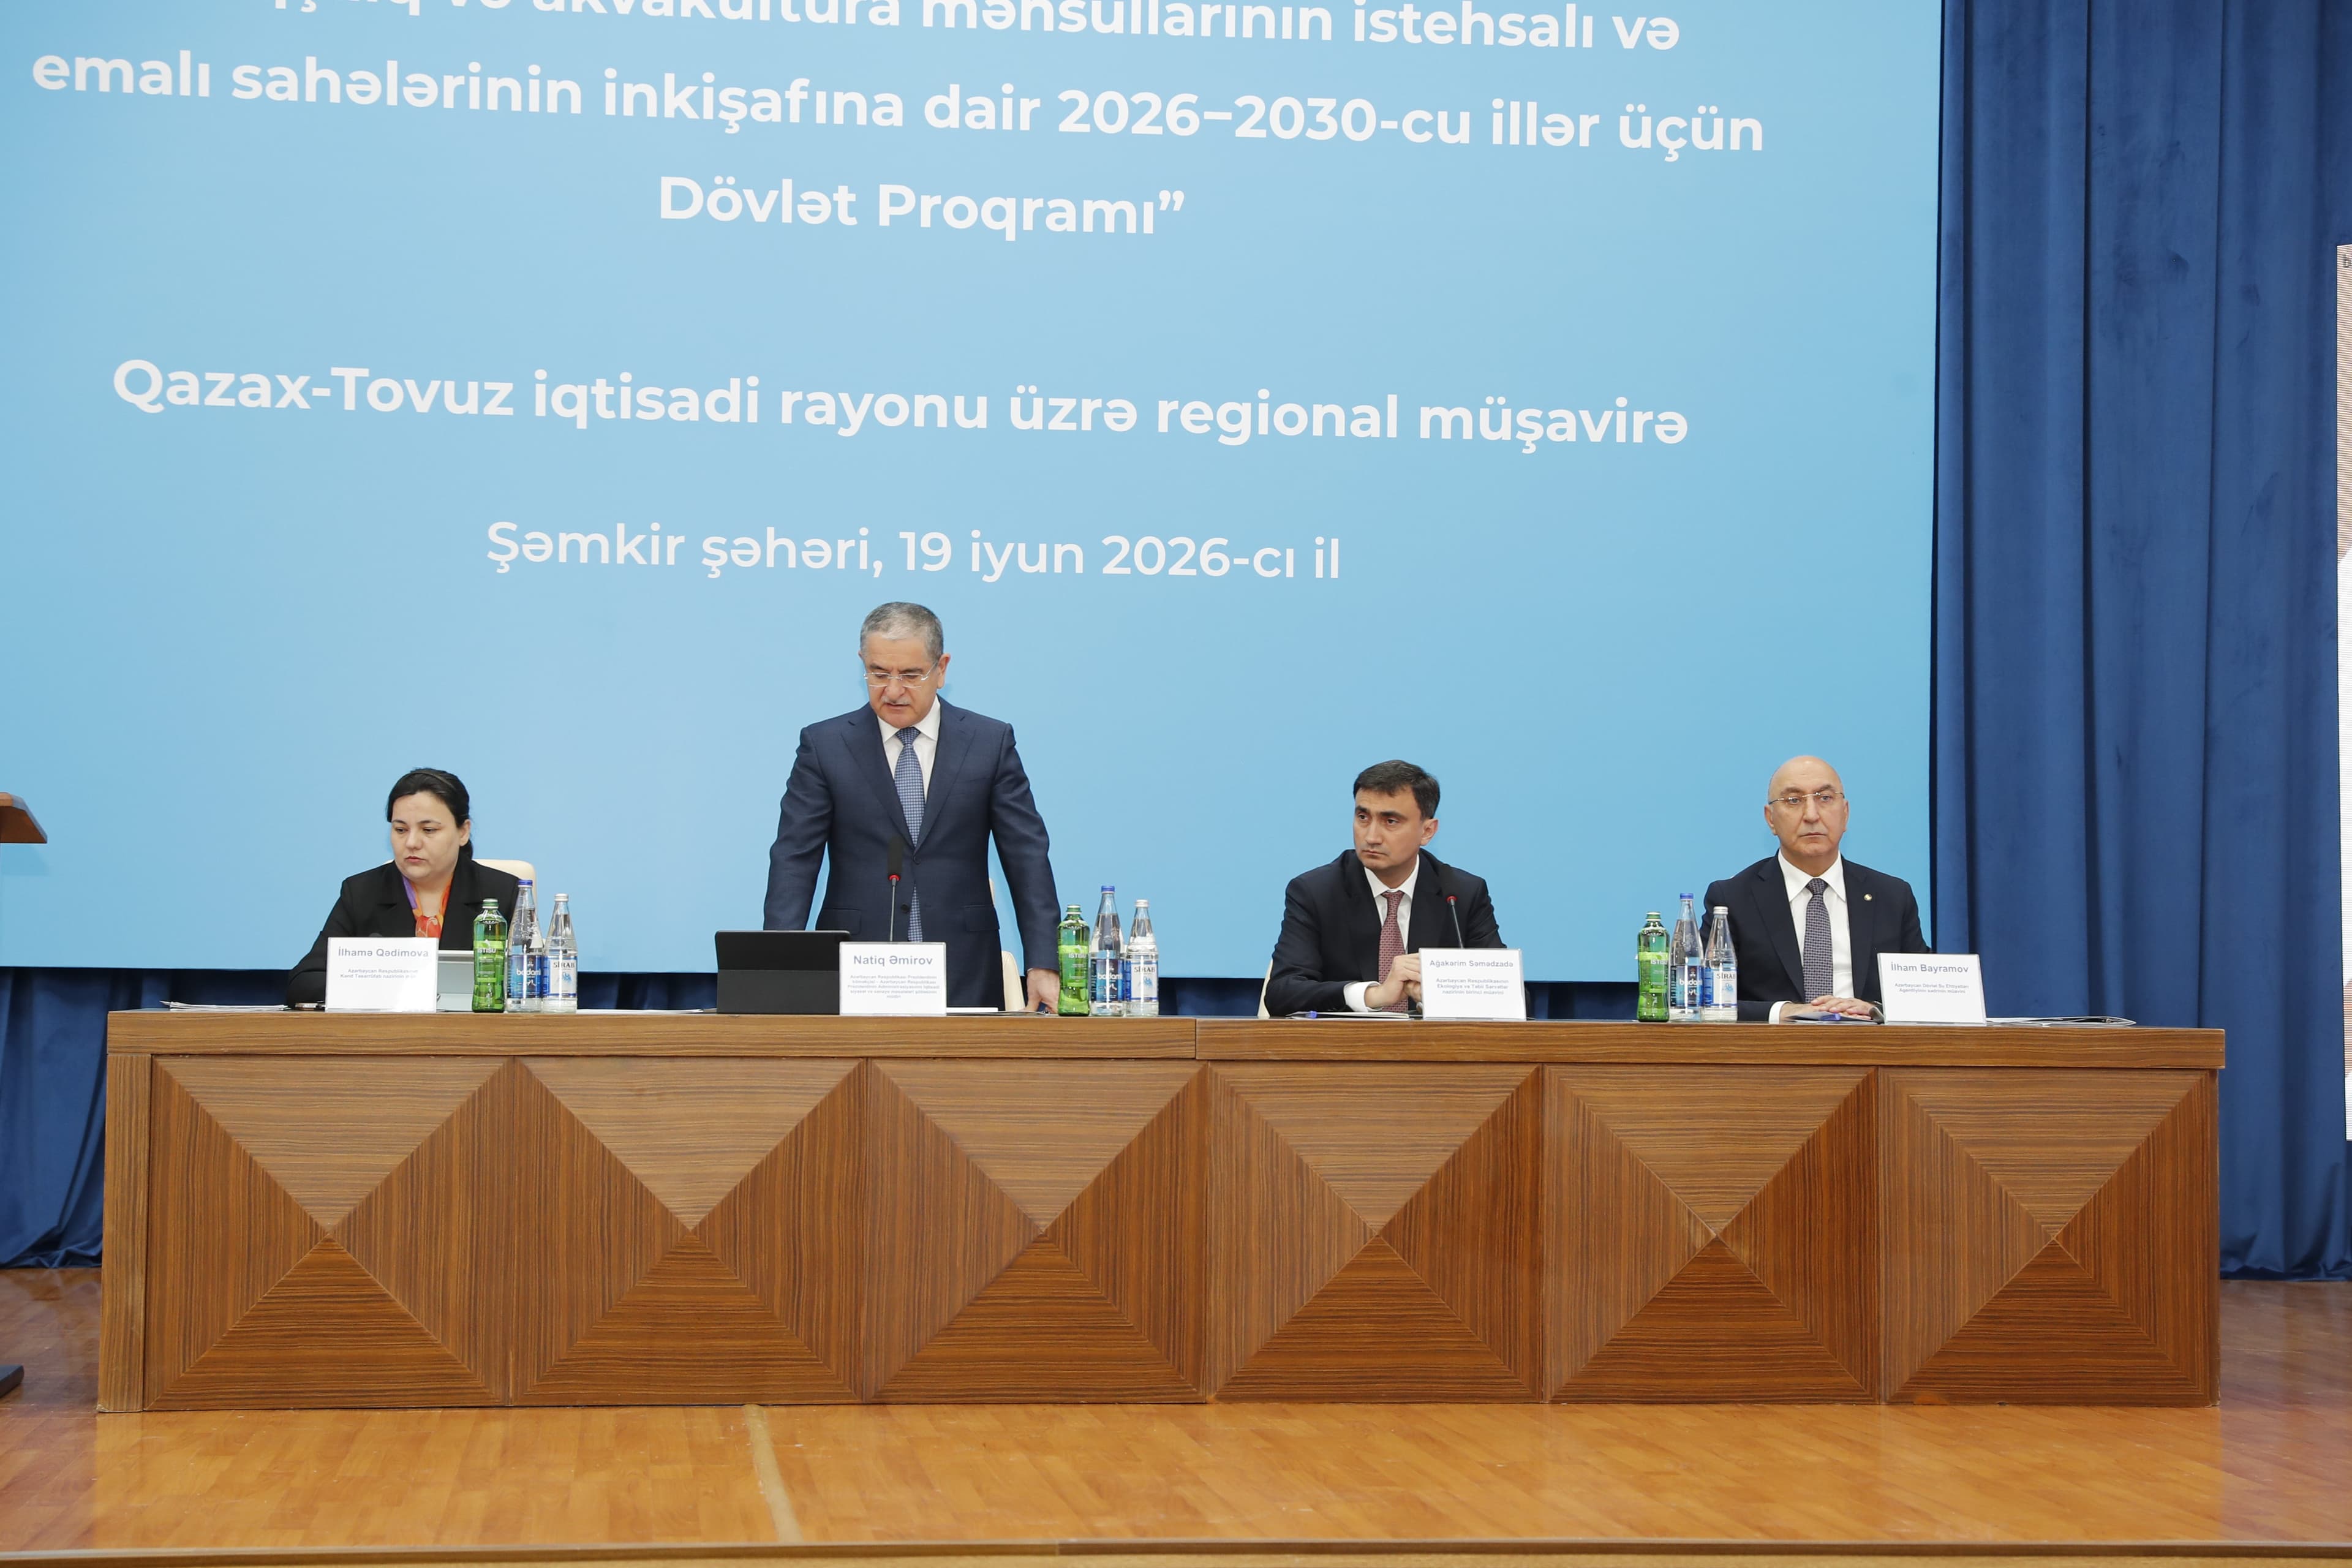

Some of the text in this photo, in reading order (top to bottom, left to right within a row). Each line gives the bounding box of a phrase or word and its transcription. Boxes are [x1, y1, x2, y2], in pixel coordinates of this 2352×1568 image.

[922, 0, 1333, 41] məhsullarının
[1353, 0, 1594, 48] istehsalı
[1611, 15, 1680, 51] və
[32, 49, 210, 97] emalı
[232, 55, 582, 115] sahələrinin
[603, 67, 904, 135] inkişafına
[924, 82, 1041, 132] dair
[1491, 97, 1600, 148] illər
[1619, 103, 1763, 163] üçün
[660, 175, 859, 227] Dövlət
[113, 359, 1688, 454] Qazax-Tovuz iqtisadi rayonu üzrə regional müşavirə
[486, 521, 1340, 583] Şəmkir şəhəri, 19 iyun 2026-cı il
[338, 946, 429, 957] İlhamə Qədimova
[853, 955, 933, 967] Natiq Əmirov
[1429, 960, 1467, 968] Ağakərim
[1891, 961, 1969, 974] İlham Bayramov
